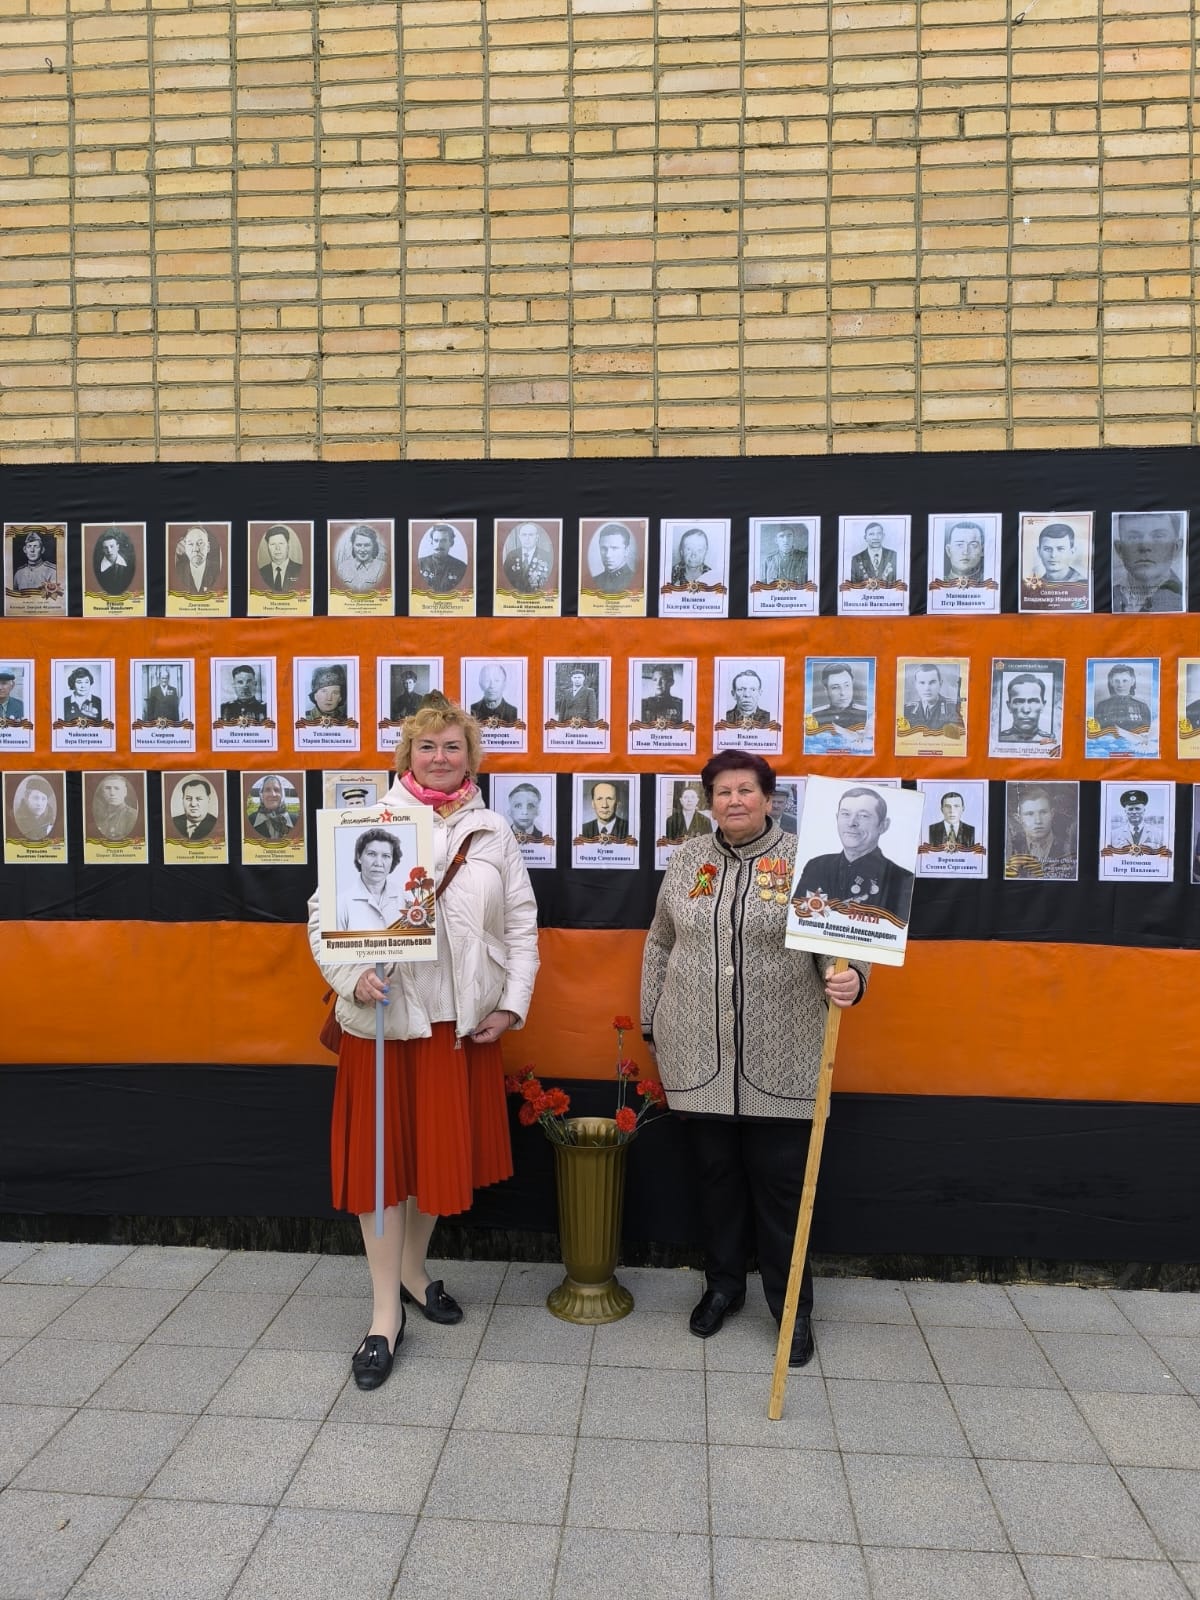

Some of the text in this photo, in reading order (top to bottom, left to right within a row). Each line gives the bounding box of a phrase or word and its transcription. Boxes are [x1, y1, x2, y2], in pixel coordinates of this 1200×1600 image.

[825, 921, 850, 933] Алексей
[850, 926, 897, 941] Александрович
[326, 937, 432, 950] Кулешова Мария Васильевна
